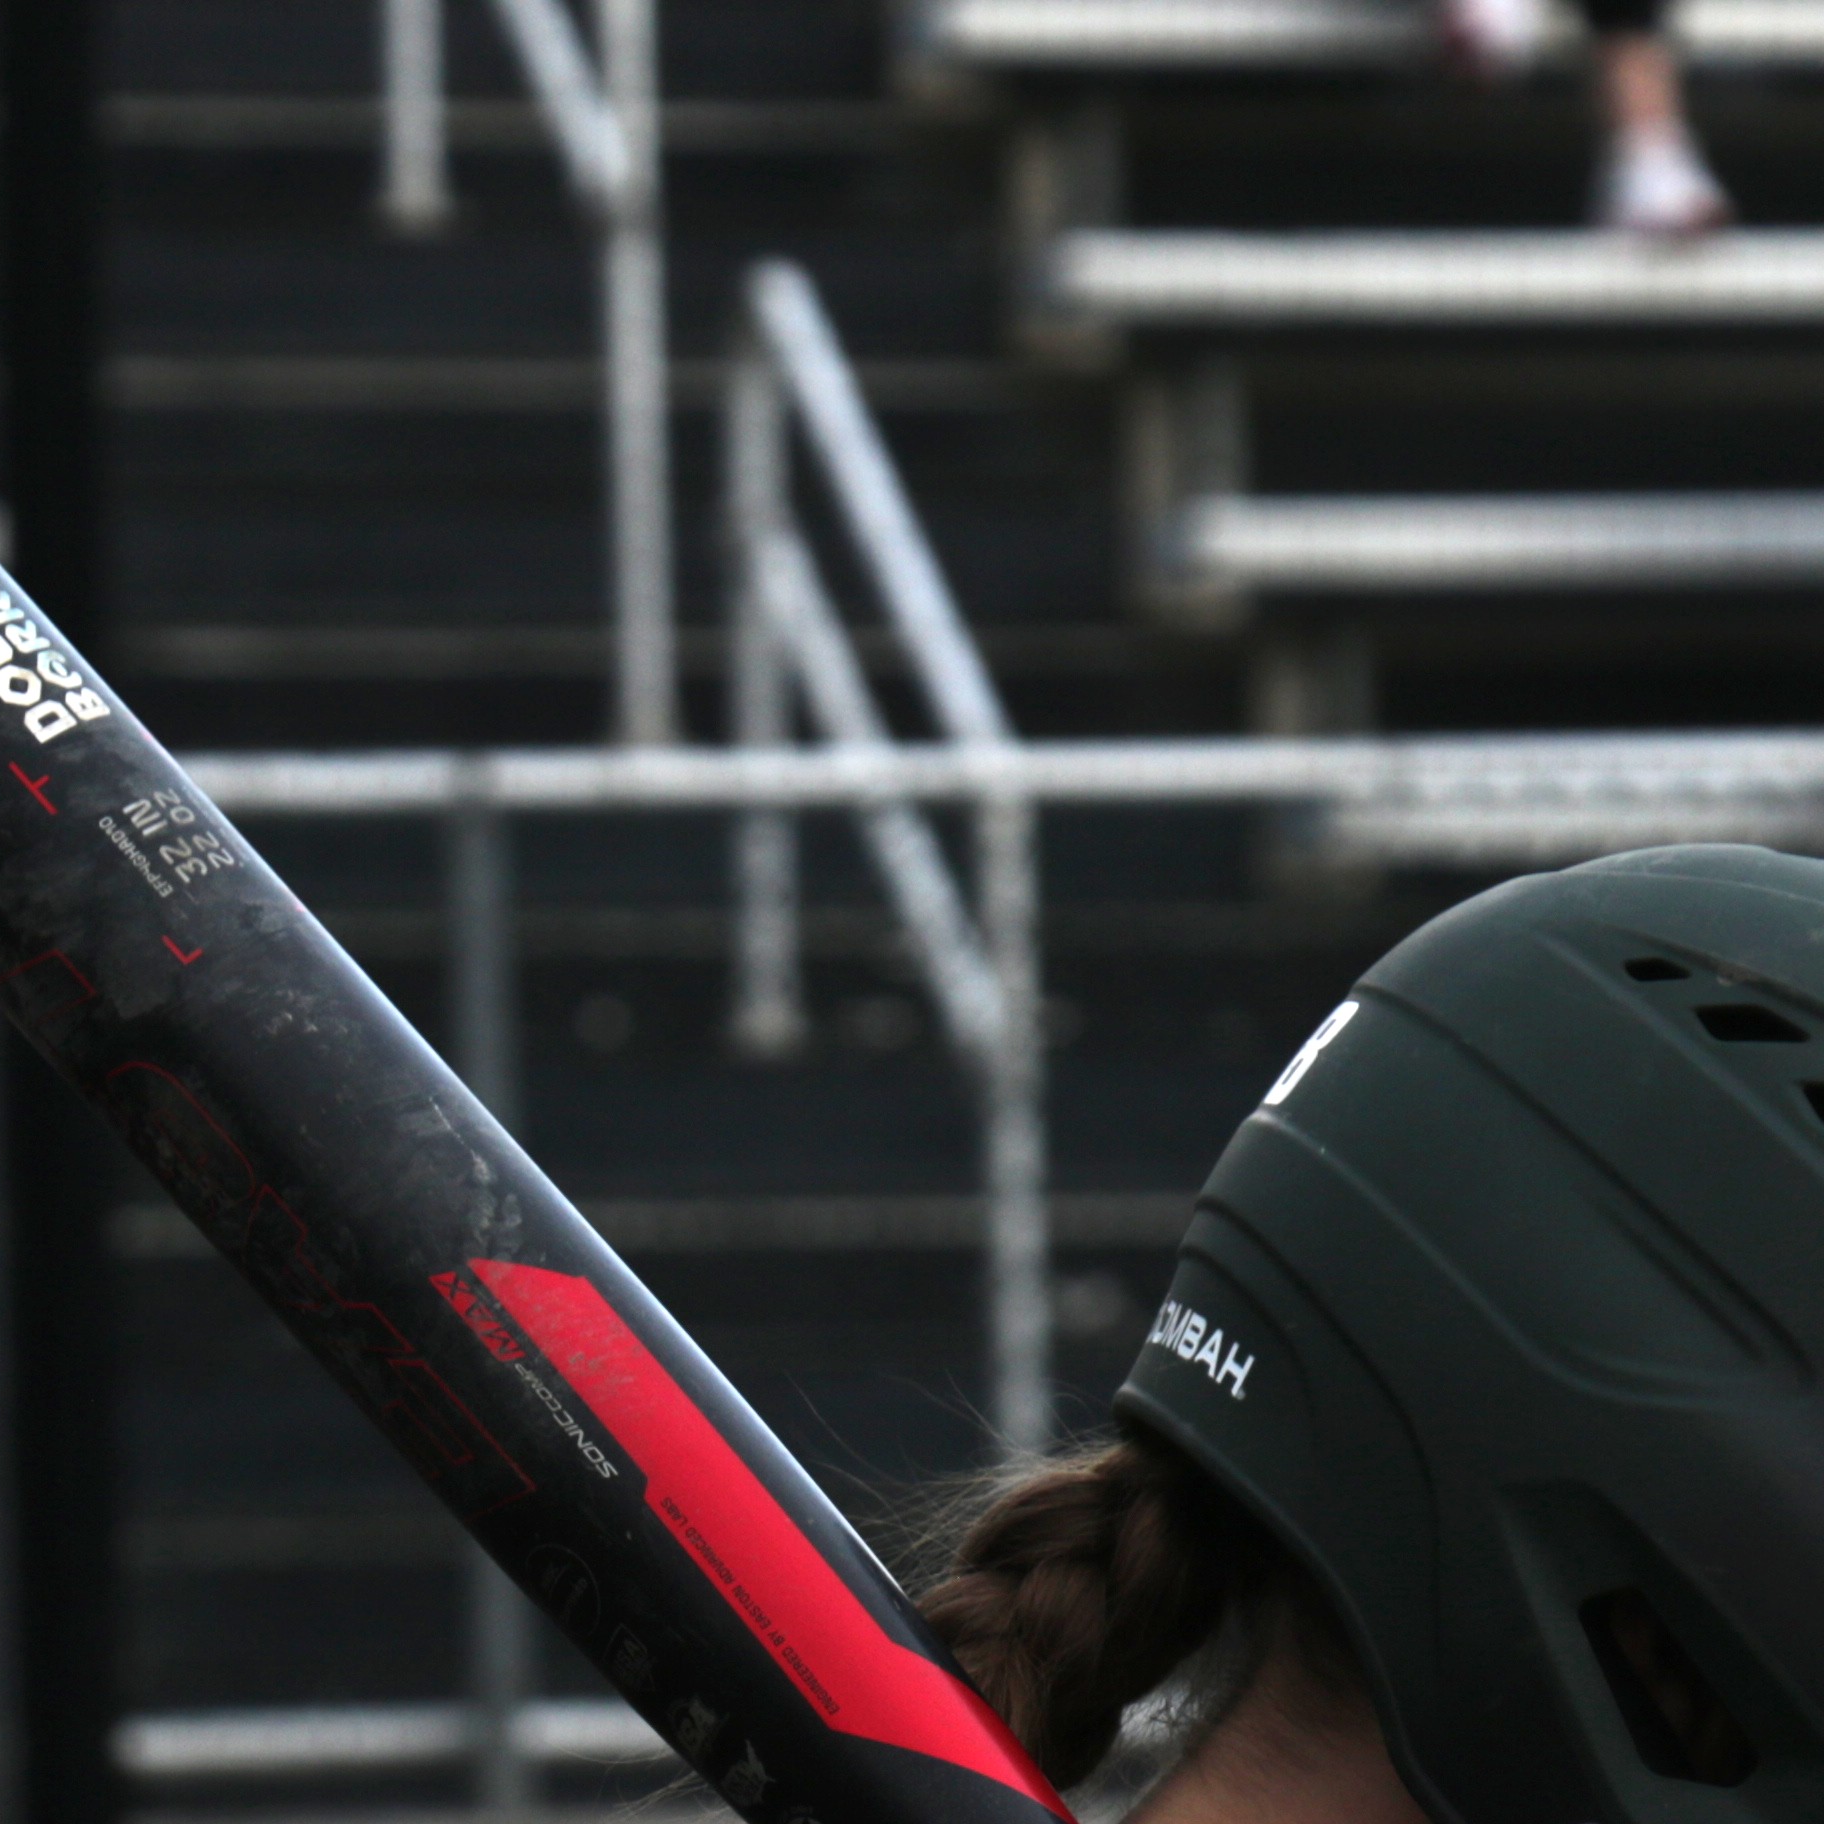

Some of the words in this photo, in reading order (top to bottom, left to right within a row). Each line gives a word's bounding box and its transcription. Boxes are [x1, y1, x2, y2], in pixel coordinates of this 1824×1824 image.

[120, 795, 169, 836] IN
[151, 786, 197, 827] OZ
[156, 835, 211, 884] 32
[190, 829, 236, 869] 22
[658, 1496, 689, 1528] LABS
[683, 1524, 736, 1585] ADVANCED
[730, 1583, 772, 1630] EASTON
[765, 1628, 785, 1647] BY
[780, 1645, 841, 1715] ENGINEERED
